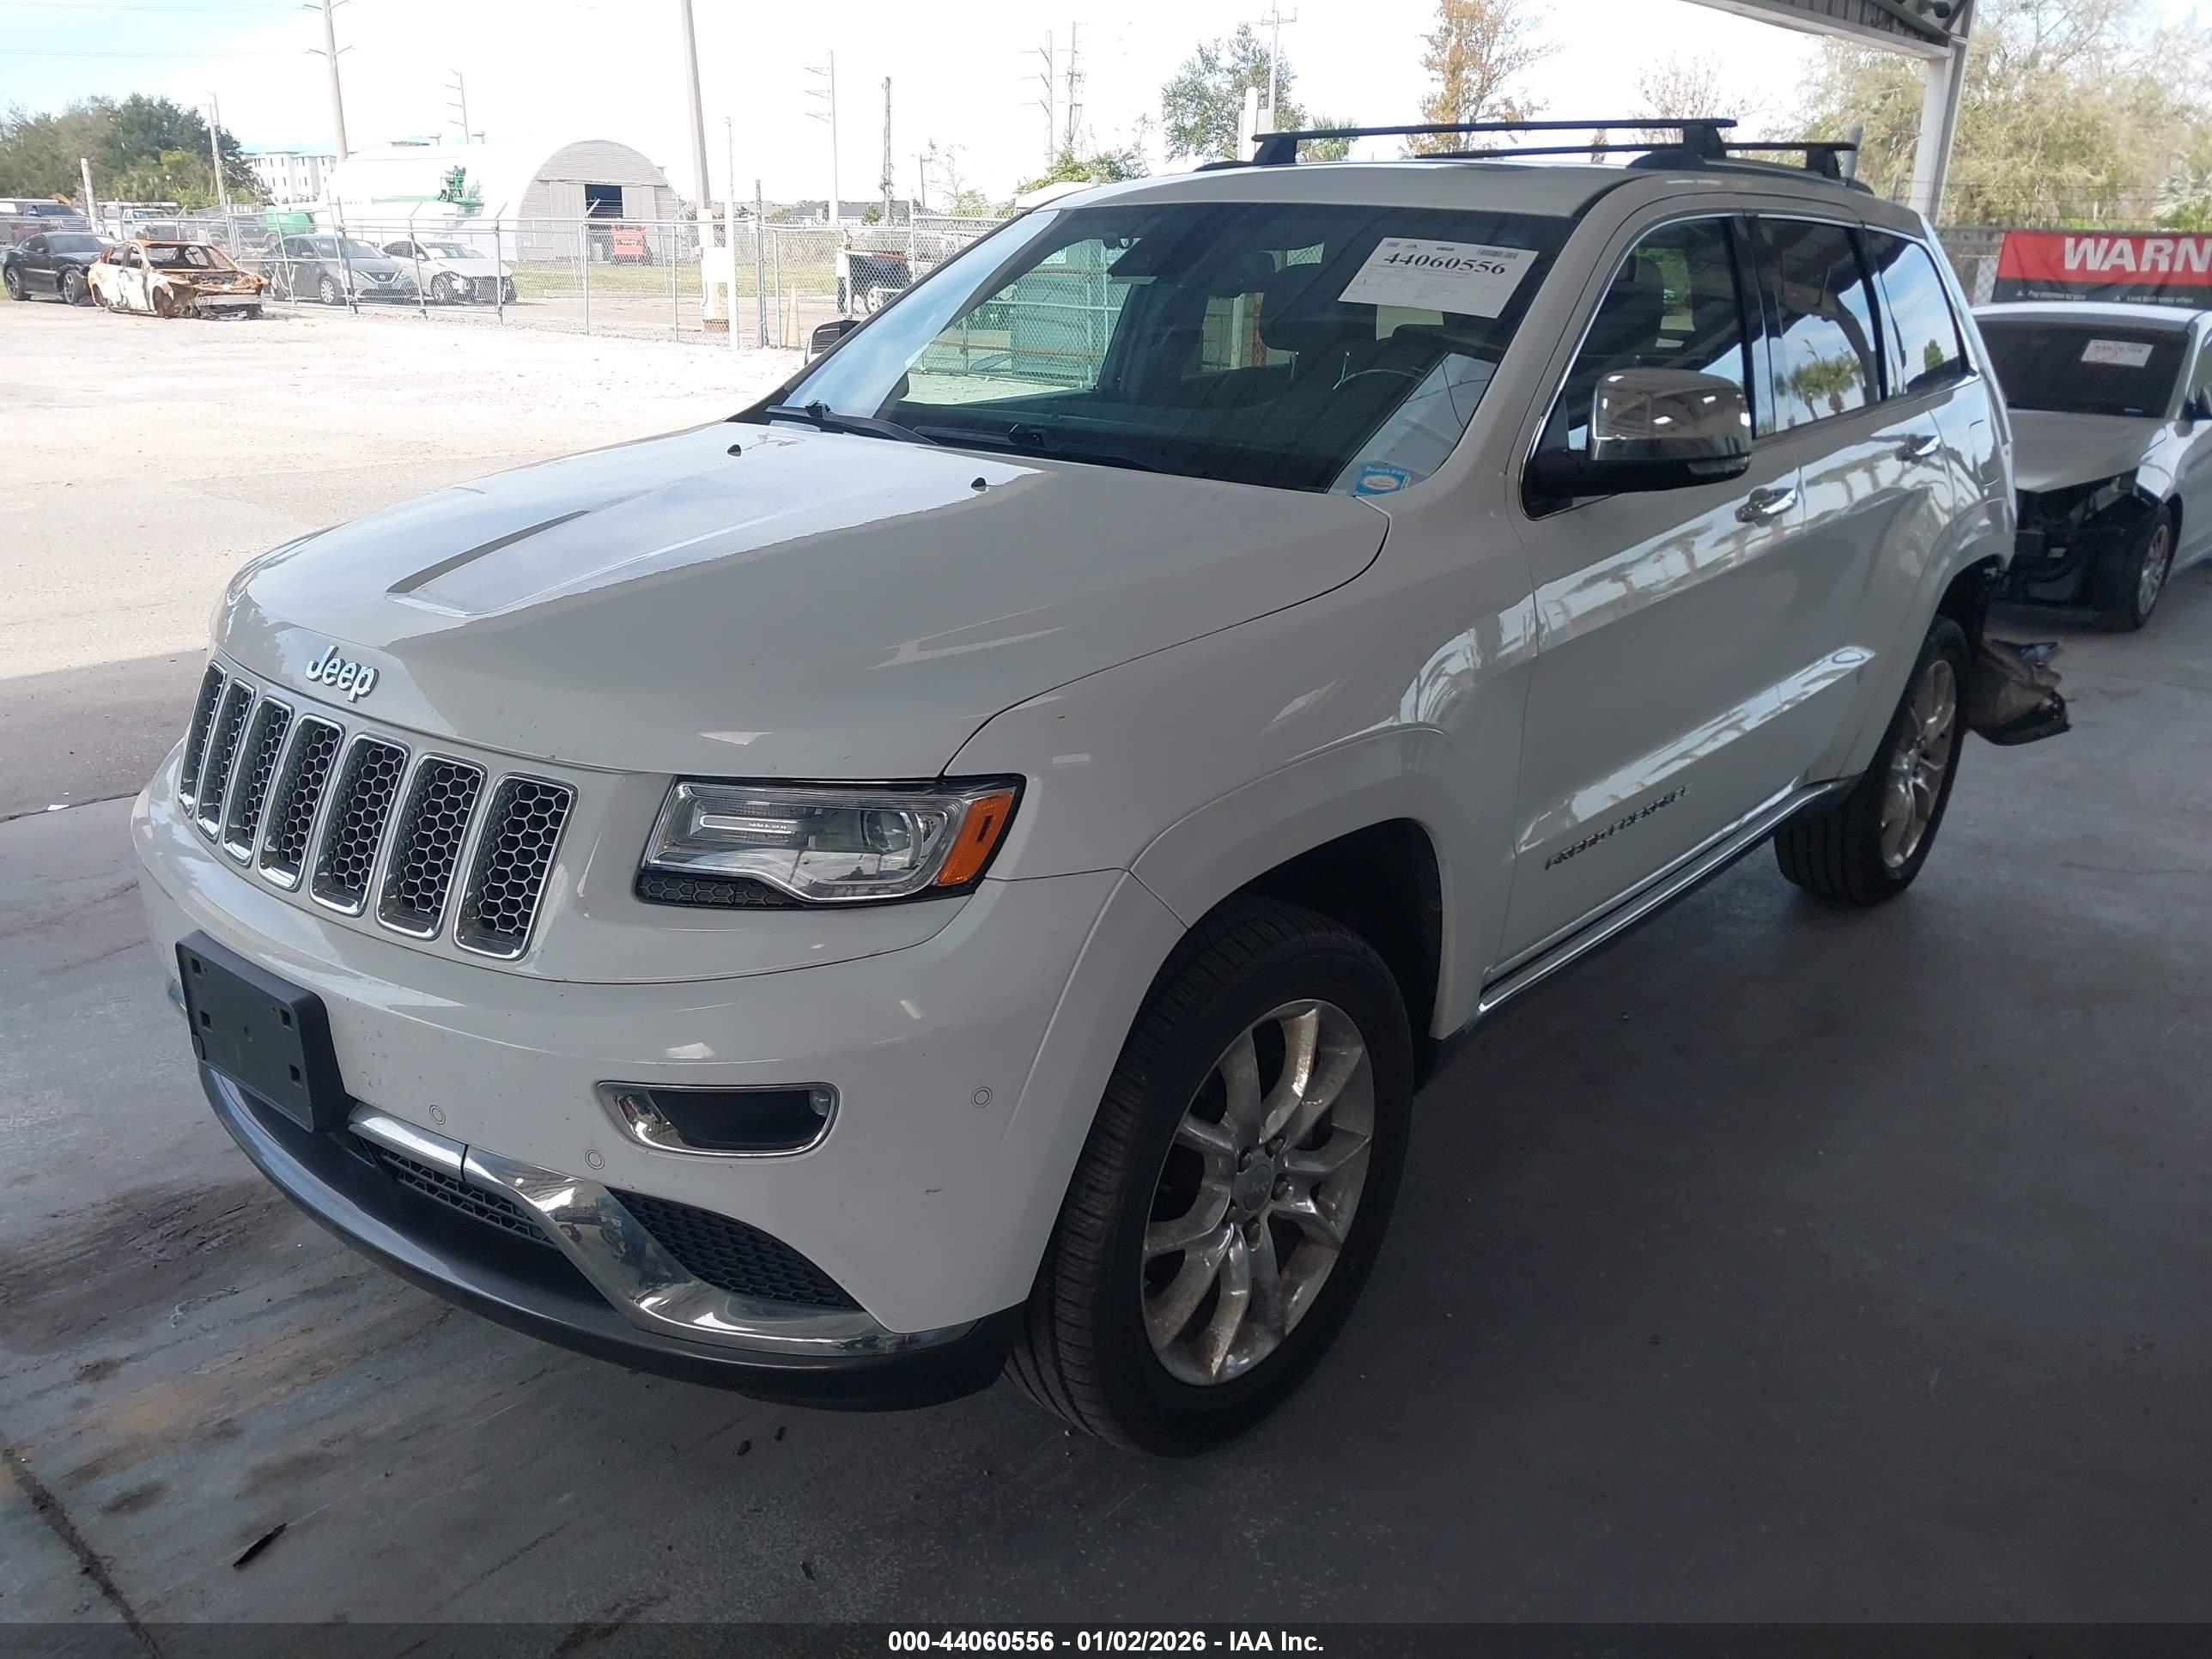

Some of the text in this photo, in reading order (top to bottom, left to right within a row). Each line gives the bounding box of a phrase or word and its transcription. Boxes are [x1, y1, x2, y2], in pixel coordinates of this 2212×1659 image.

[1382, 252, 1509, 275] 44060556
[2063, 237, 2212, 273] WARN
[305, 645, 380, 703] Jeep
